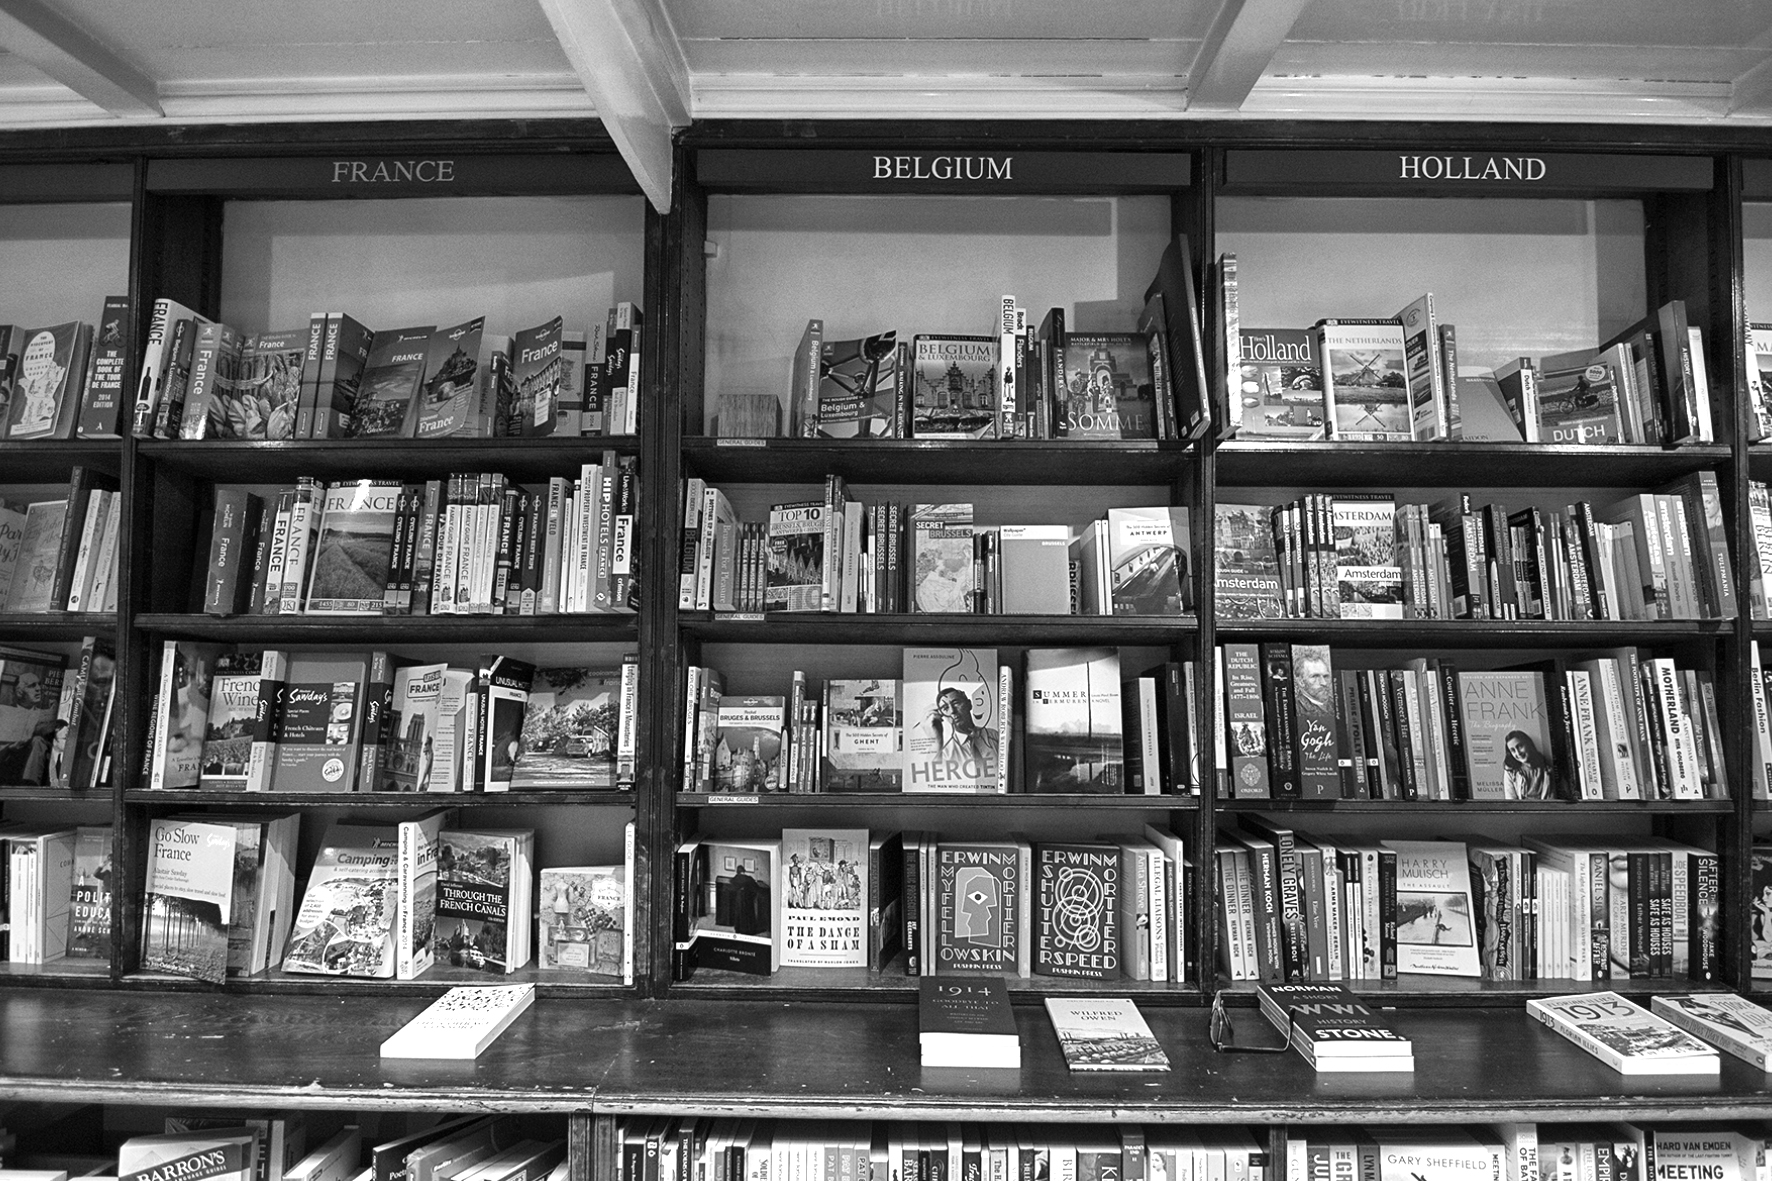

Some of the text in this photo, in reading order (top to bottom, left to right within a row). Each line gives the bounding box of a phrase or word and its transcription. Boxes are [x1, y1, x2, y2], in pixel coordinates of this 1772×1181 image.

[332, 161, 455, 182] FRANCE
[872, 157, 1013, 180] BELGIUM
[1400, 156, 1546, 180] HOLLAND
[148, 302, 169, 346] FRANCE
[1003, 298, 1014, 335] BELGIUM
[308, 323, 321, 360] FRANCE
[326, 323, 338, 360] FRANCE
[919, 344, 990, 356] BELGIUM
[1241, 336, 1312, 361] Holland
[97, 358, 124, 366] COMPLETE
[392, 353, 424, 362] FRANCE
[522, 341, 559, 364] France
[927, 354, 991, 362] LUXEMBOURG
[1016, 339, 1024, 369] Flanders
[92, 381, 121, 389] DE FRANCE
[108, 374, 121, 382] TOUR
[588, 366, 599, 410] FRANCE
[821, 403, 858, 413] Belgium
[821, 411, 858, 419] Luxembourg
[418, 416, 454, 434] France
[1068, 412, 1144, 432] SOMME
[1553, 424, 1606, 442] DUTCH
[603, 477, 612, 502] HIP
[601, 503, 611, 544] HOTELS
[778, 509, 820, 522] TOP 10
[289, 508, 305, 566] FRANCE
[930, 530, 972, 538] BRUSSELS
[1659, 500, 1674, 556] amsterdam
[1677, 500, 1691, 556] amsterdam
[270, 520, 287, 573] FRANCE
[616, 518, 629, 563] France
[888, 506, 898, 571] SECRET BRUSSELS
[1465, 520, 1477, 572] AMSTERDAM
[392, 544, 401, 569] FRANCE
[405, 544, 413, 569] FRANCE
[683, 530, 696, 572] BELGIUM
[877, 534, 885, 571] BRUSSELS
[1345, 569, 1401, 579] Amsterdam
[1718, 553, 1730, 597] TULIPMANIA
[1419, 568, 1427, 605] AMSTERDAM
[410, 683, 440, 694] FRANCE
[496, 677, 517, 686] UNUSUAL
[1465, 681, 1529, 699] ANNE
[289, 688, 328, 705] Sawday's
[1033, 690, 1087, 700] SUMMER
[1661, 667, 1680, 734] MOTHERLAND
[1752, 667, 1766, 734] Berlin Fashion
[1466, 702, 1547, 720] FRANK
[1577, 675, 1594, 745] ANNE FRANK
[1307, 720, 1326, 733] Van
[1301, 732, 1335, 751] Gogh
[910, 752, 996, 783] HERGÉ
[156, 827, 200, 845] Go Slow
[155, 843, 191, 862] France
[337, 853, 390, 867] Camping
[941, 850, 1001, 865] ERWIN
[1042, 850, 1102, 867] ERWIN
[1402, 859, 1447, 869] HARRY
[1262, 853, 1274, 914] HERMAN KOCH
[1280, 835, 1298, 921] LONELY GRAVES
[1402, 869, 1448, 879] MULISCH
[1698, 858, 1709, 905] SILENCE
[1708, 858, 1718, 894] AFTER
[444, 888, 502, 904] THROUGH THE
[1002, 854, 1016, 948] MORTIER
[1103, 854, 1117, 954] MORTIER
[1153, 856, 1163, 940] ILLEGAL LIAISONS
[440, 901, 506, 917] FRENCH CANALS
[788, 926, 814, 937] THE
[788, 939, 860, 951] OF A SHAM
[938, 986, 992, 996] 1914
[1289, 1004, 1370, 1016] WWI
[1554, 1001, 1635, 1020] 1913
[1683, 1142, 1701, 1150] VAN
[1703, 1142, 1731, 1150] EMDEN
[1336, 1152, 1351, 1160] THE
[1388, 1155, 1487, 1170] GARY SHEFFIELD
[1657, 1165, 1724, 1180] MEETING
